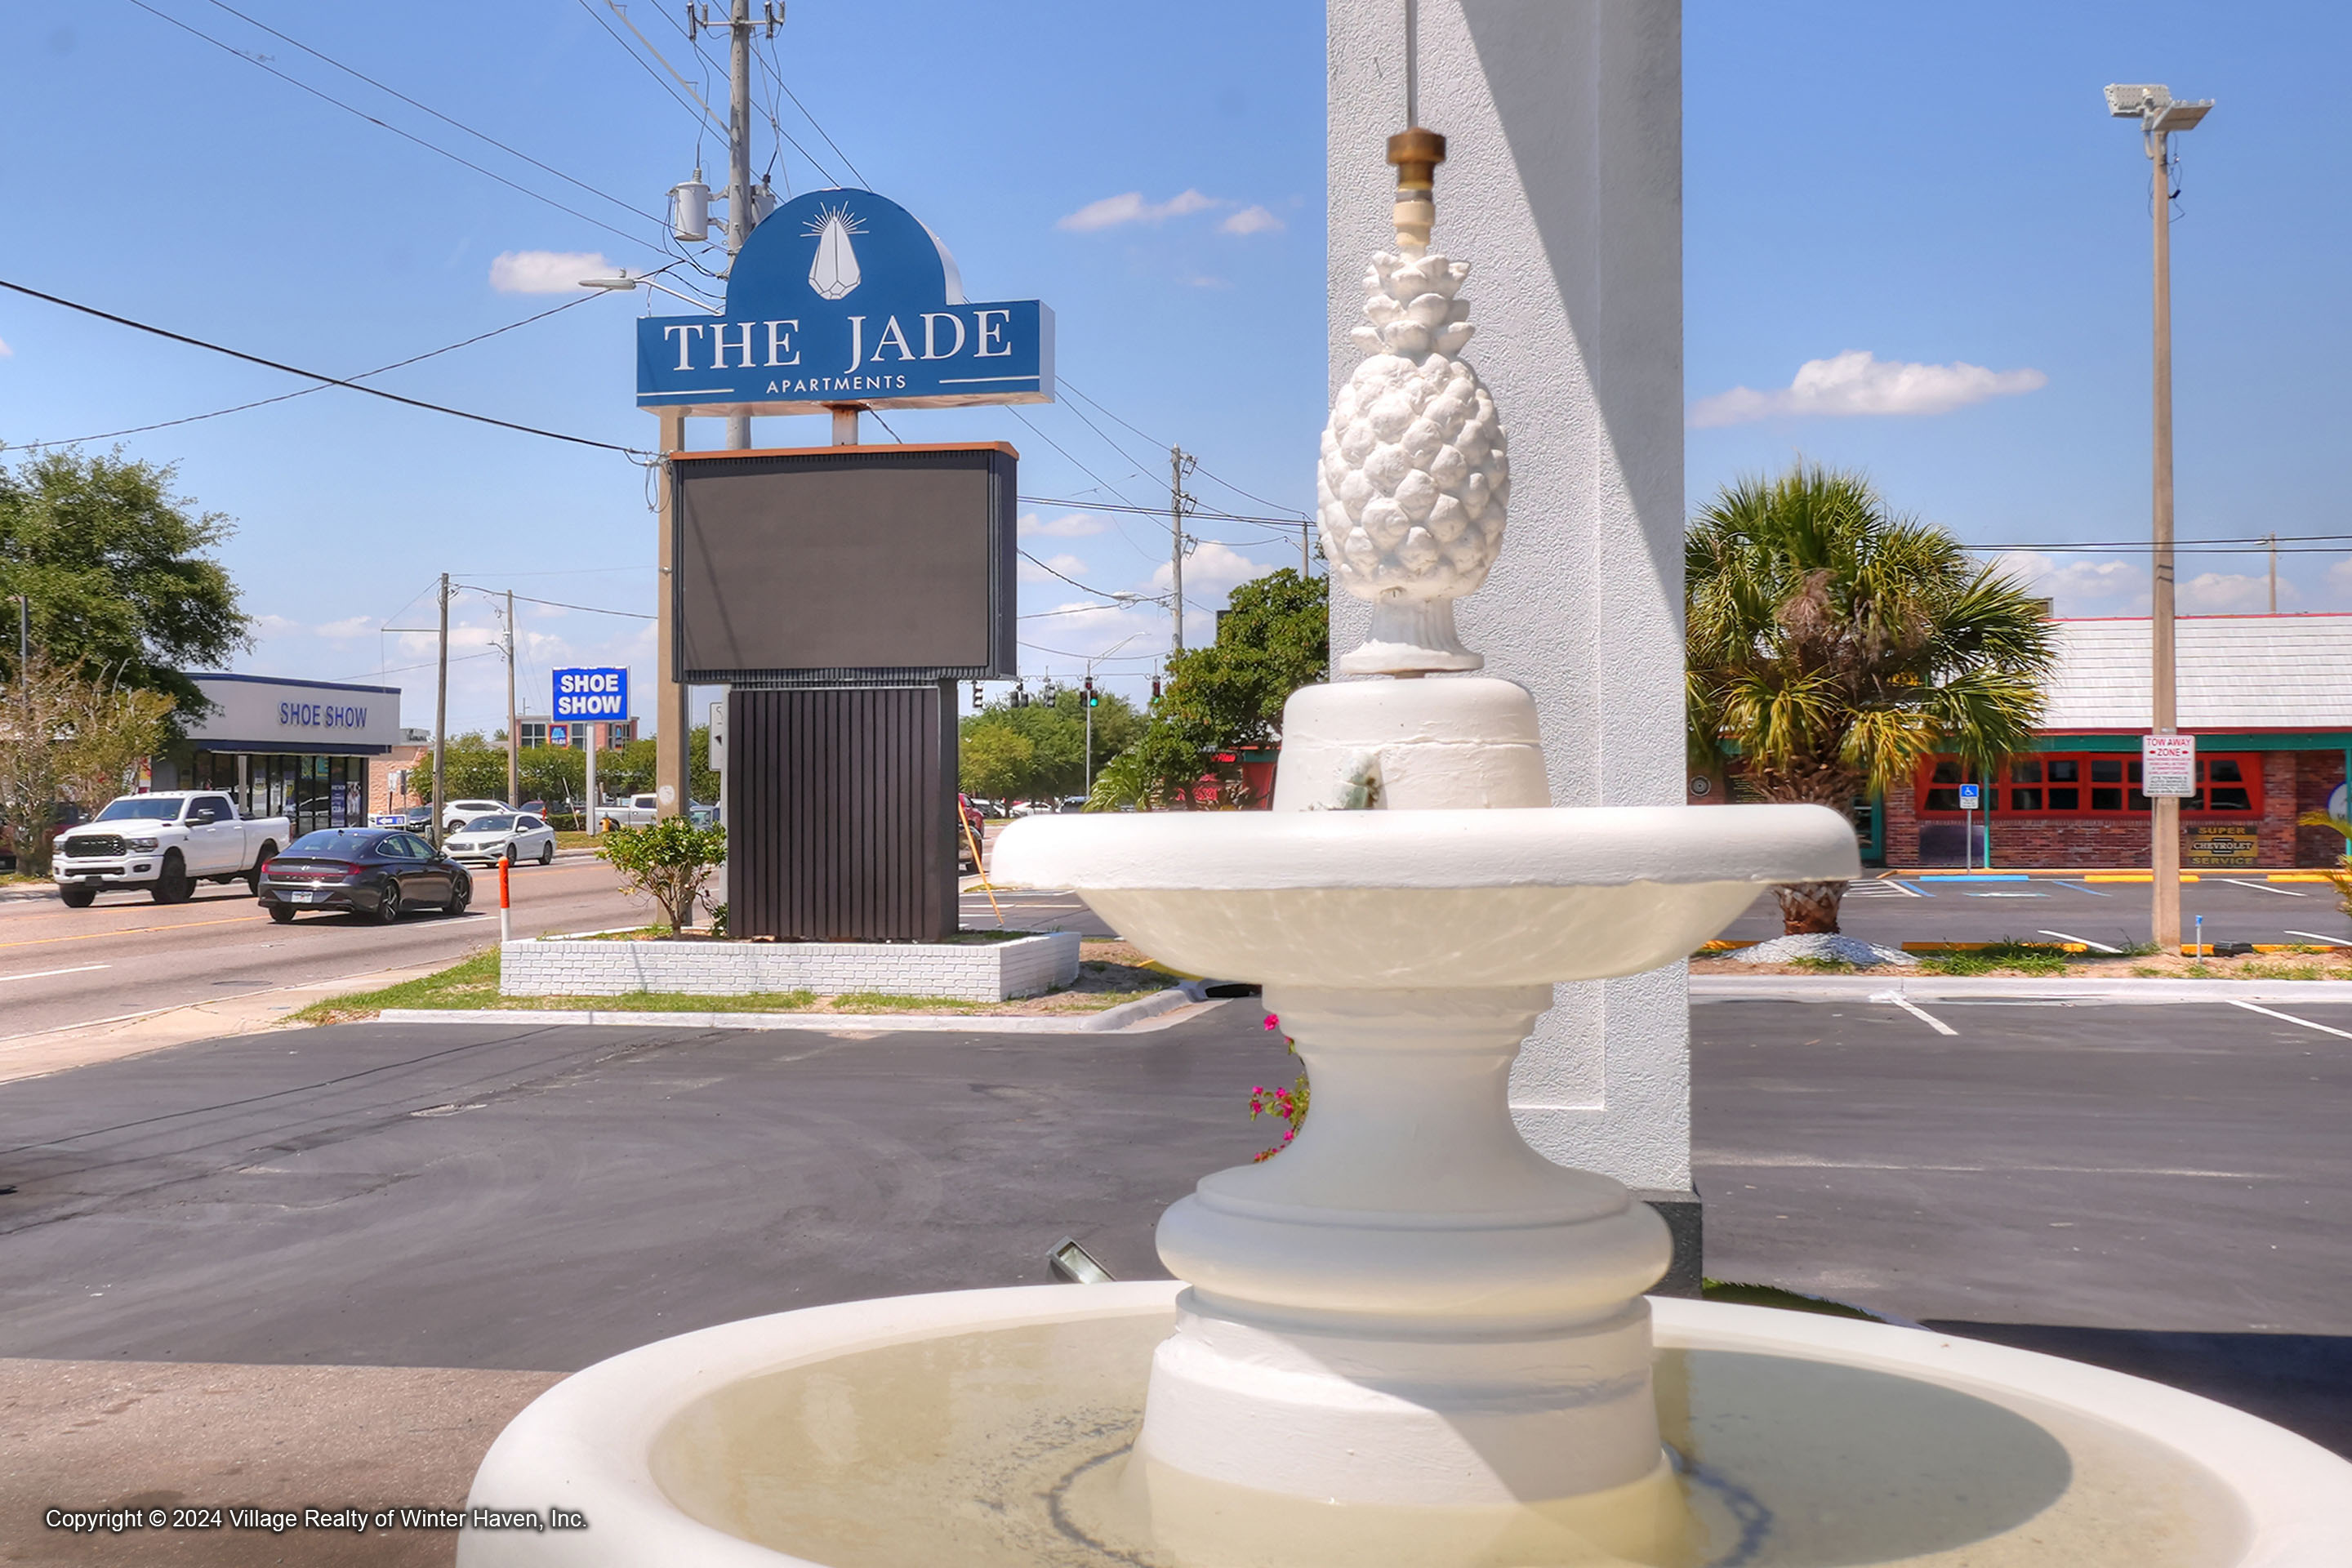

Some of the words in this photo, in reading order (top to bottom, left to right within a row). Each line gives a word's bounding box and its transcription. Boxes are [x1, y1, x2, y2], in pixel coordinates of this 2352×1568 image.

[664, 318, 801, 372] THE
[844, 309, 1012, 374] JADE
[766, 375, 906, 394] APARTMENTS
[560, 674, 619, 693] SHOE
[280, 702, 321, 725] SHOE
[326, 706, 367, 727] SHOW
[558, 695, 621, 715] SHOW
[2157, 748, 2180, 756] ZONE
[2198, 826, 2246, 835] SUPER
[2191, 857, 2252, 865] SERVICE
